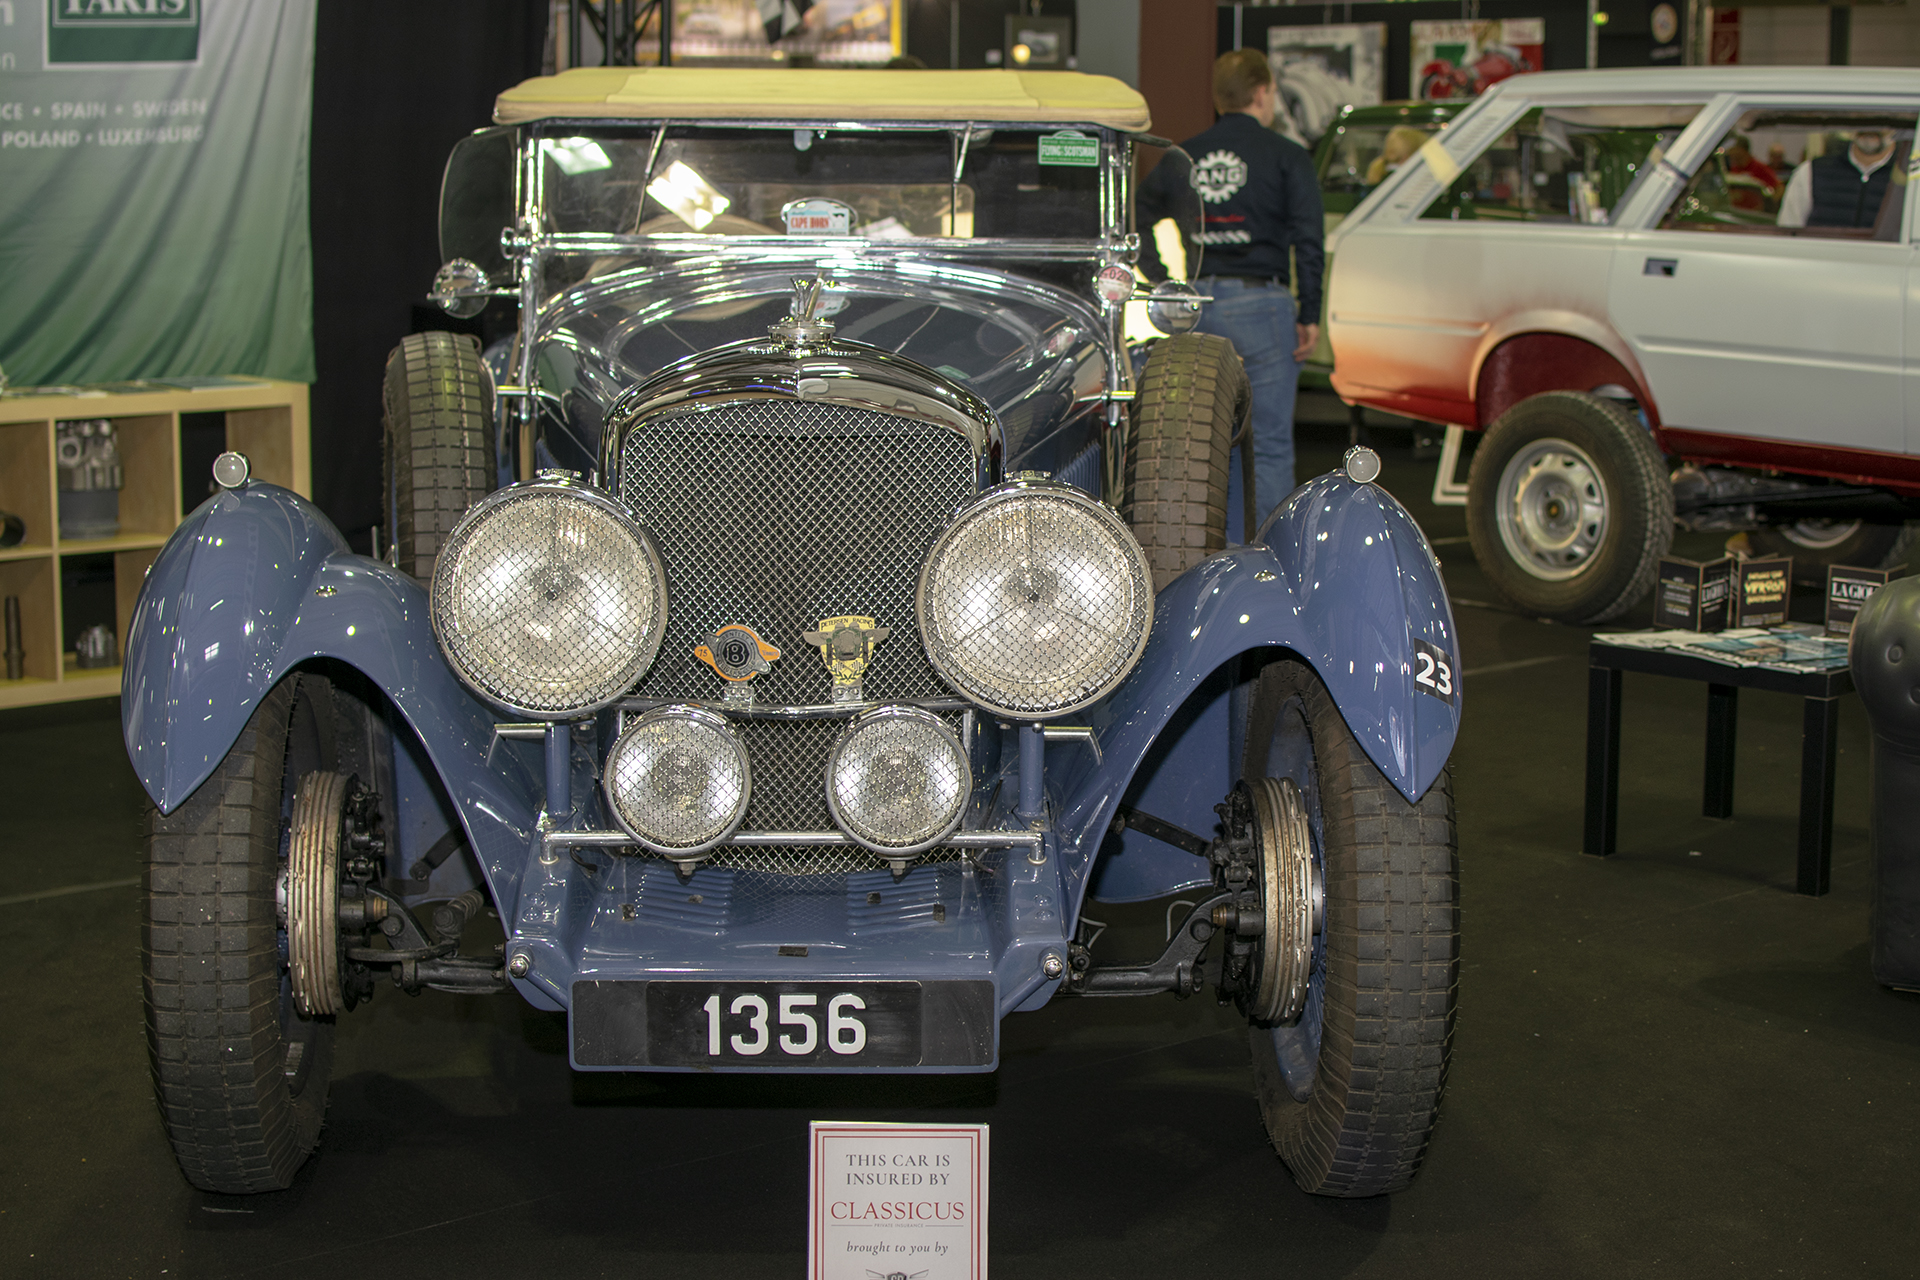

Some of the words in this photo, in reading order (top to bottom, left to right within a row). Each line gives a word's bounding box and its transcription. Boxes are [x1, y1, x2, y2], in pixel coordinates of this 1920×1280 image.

[51, 102, 106, 120] SPAIN
[2, 130, 80, 148] POLAND
[1042, 145, 1061, 156] FLYING
[1063, 146, 1096, 157] SCOTSMAN
[790, 217, 807, 229] CAPE
[810, 217, 829, 229] HORN
[820, 618, 849, 631] PETERSEN
[852, 617, 873, 629] RACING
[721, 631, 749, 641] BENTLEY
[698, 649, 708, 658] 75
[761, 649, 779, 657] Years
[1416, 652, 1452, 695] 23
[703, 993, 867, 1056] 1356
[845, 1154, 887, 1167] THIS
[892, 1154, 929, 1167] CAR
[935, 1154, 951, 1167] IS
[846, 1172, 923, 1186] INSURED
[929, 1173, 950, 1186] BY
[830, 1200, 965, 1220] CLASSICUS
[847, 1241, 890, 1256] brought
[895, 1244, 906, 1252] to
[909, 1245, 930, 1256] you
[935, 1241, 949, 1256] by
